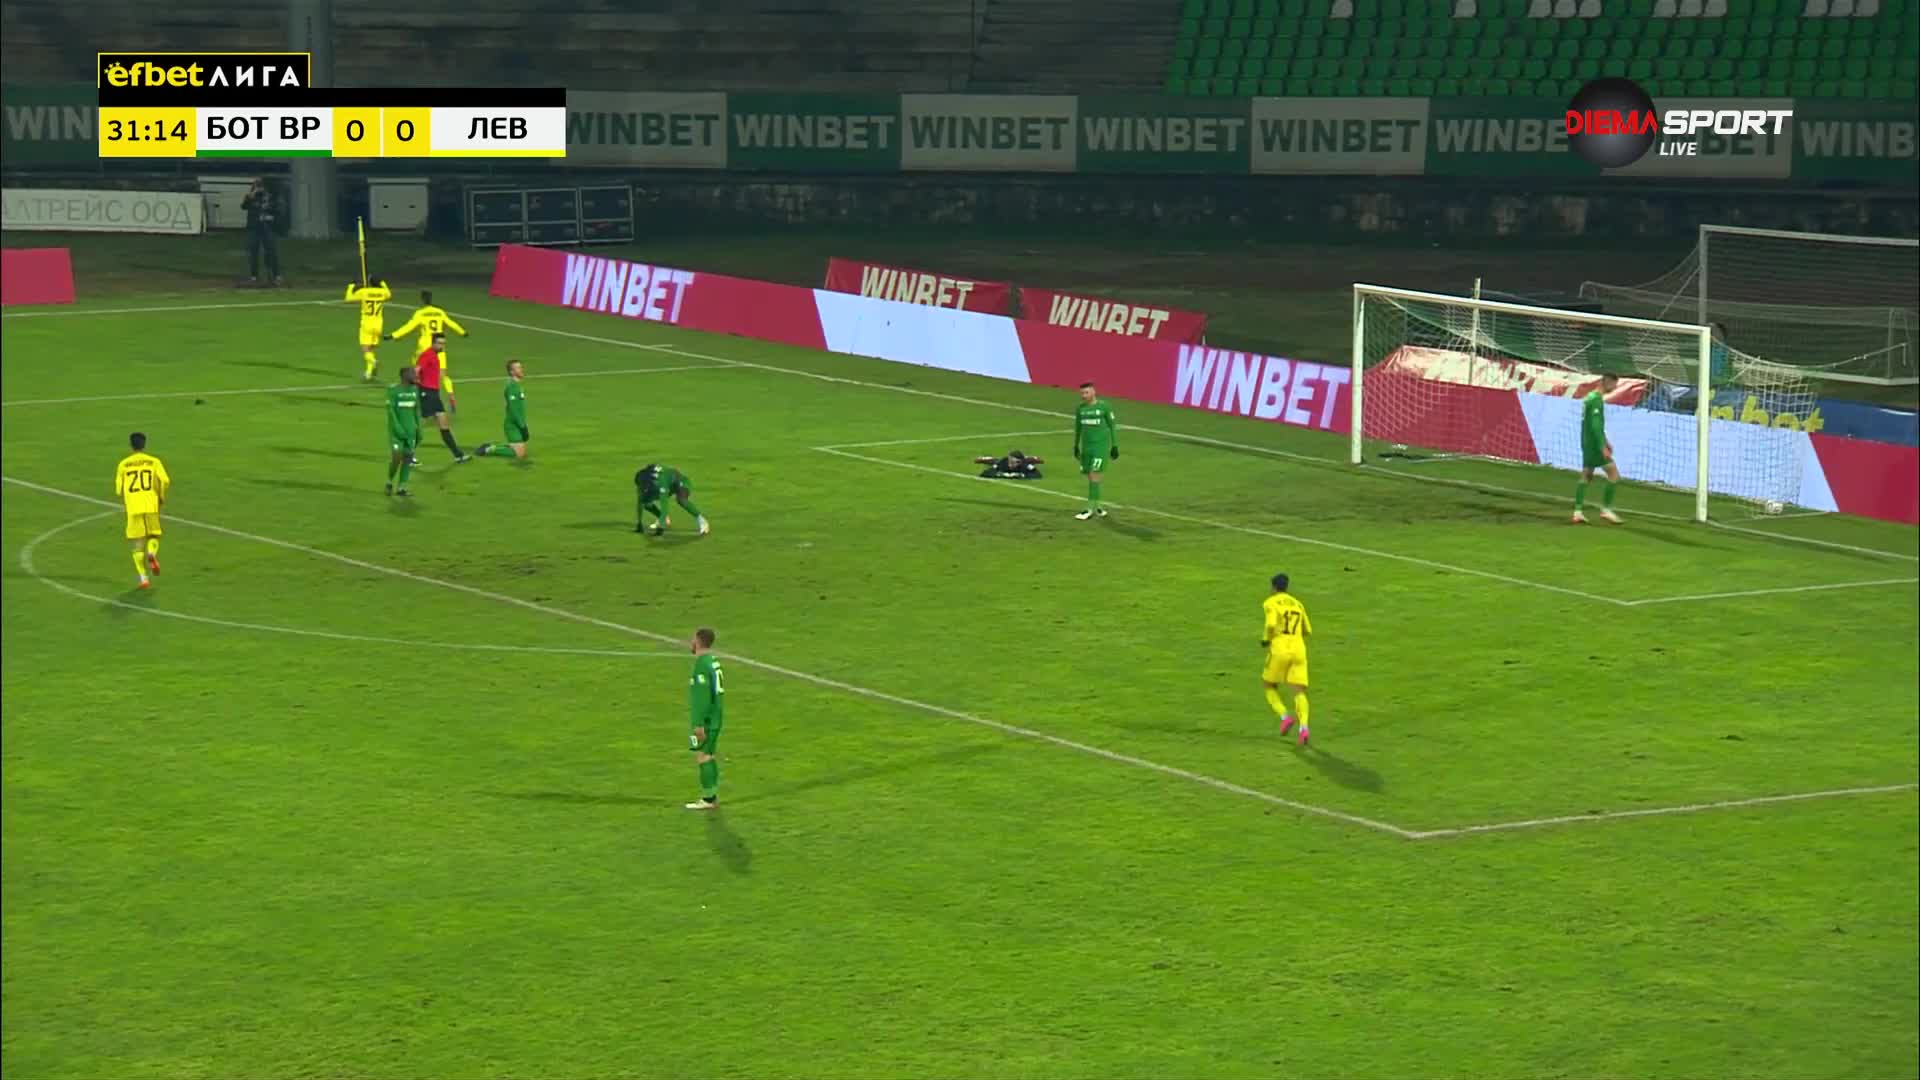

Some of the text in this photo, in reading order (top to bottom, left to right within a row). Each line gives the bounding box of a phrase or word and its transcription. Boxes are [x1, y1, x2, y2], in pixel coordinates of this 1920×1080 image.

[6, 105, 91, 141] WIN
[567, 111, 719, 146] WINBET
[734, 113, 894, 149] WINBET
[911, 115, 1068, 150] WINBET
[1084, 116, 1246, 152] WINBET
[1260, 118, 1420, 153] WINBET
[1435, 118, 1569, 153] WINBE
[132, 201, 192, 229] ООД
[562, 253, 694, 324] WINBET
[1173, 343, 1351, 430] WINBET
[126, 469, 152, 493] 20
[1281, 610, 1301, 635] 17
